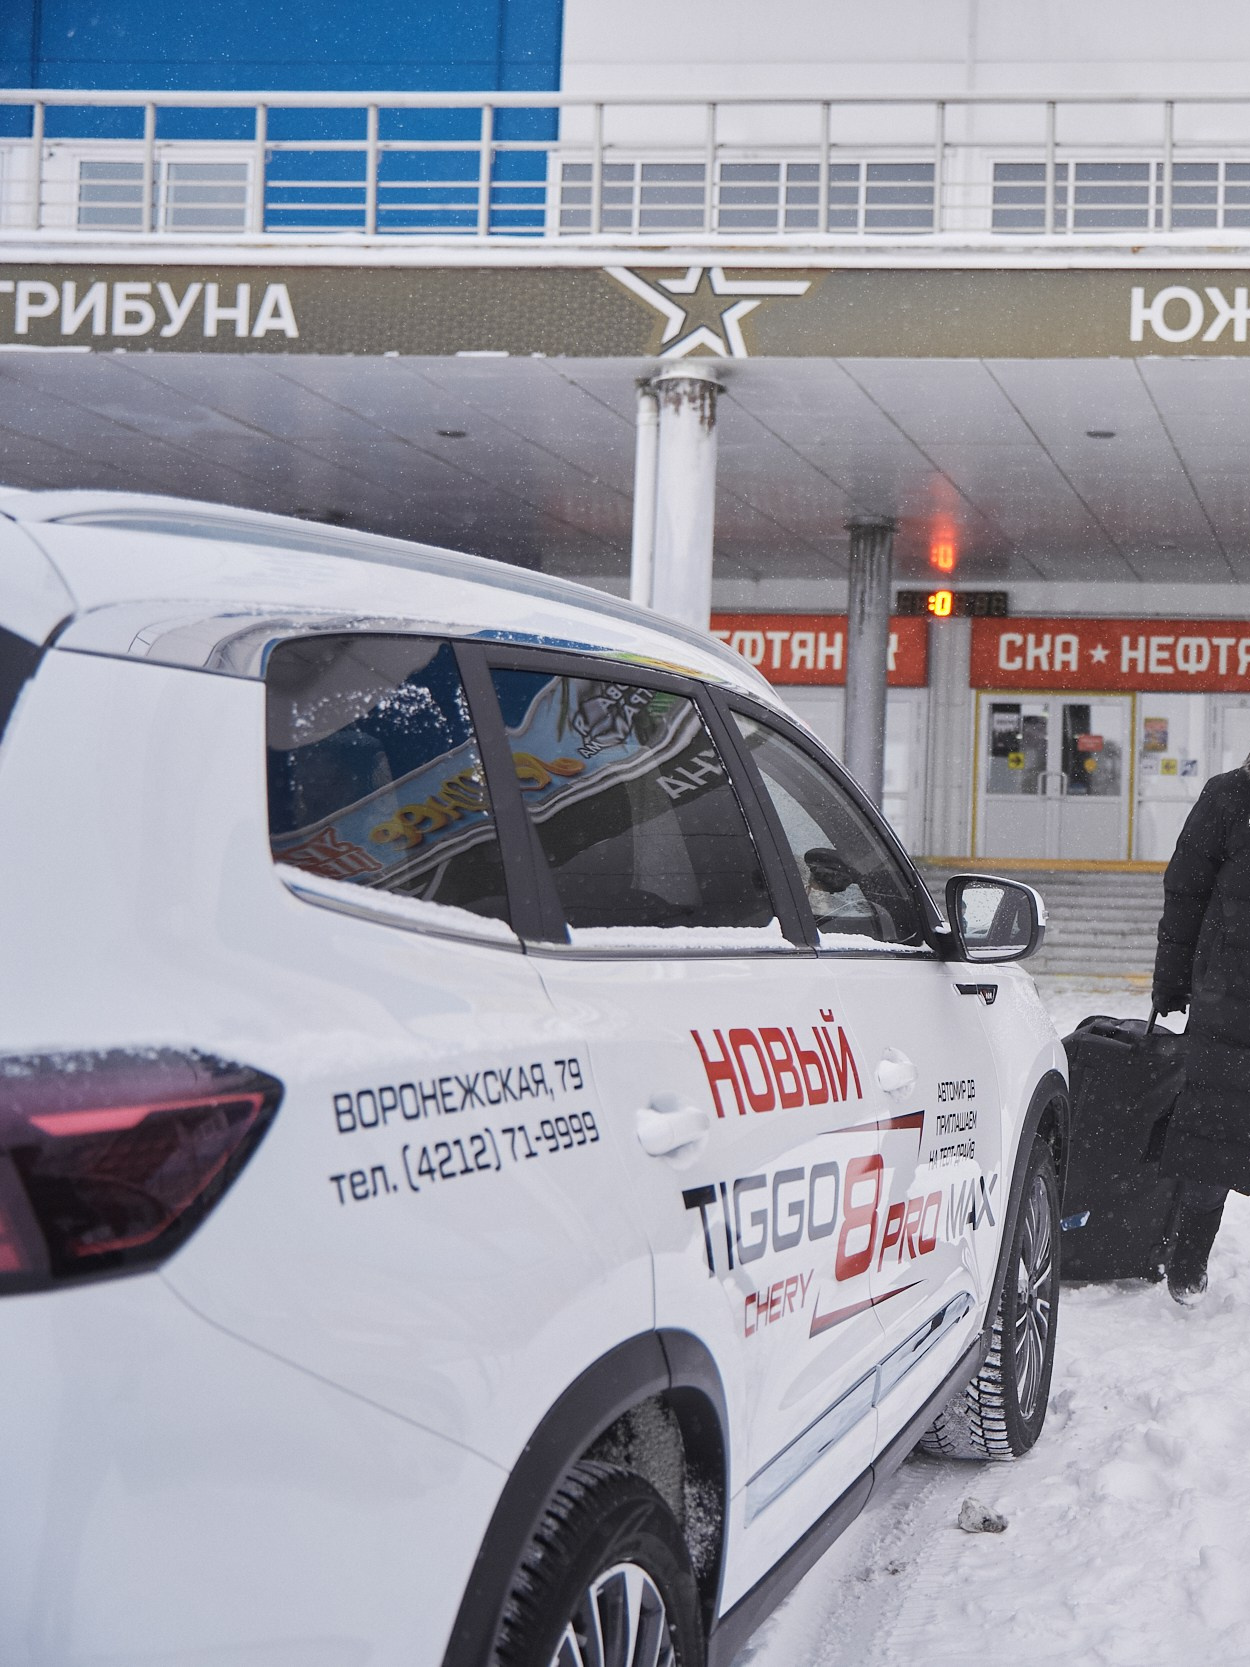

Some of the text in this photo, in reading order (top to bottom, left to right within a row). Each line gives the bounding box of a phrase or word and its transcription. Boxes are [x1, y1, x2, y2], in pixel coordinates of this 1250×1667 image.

[999, 632, 1080, 672] СКА
[333, 1058, 583, 1134] ВОРОНЕЖСКАЯ, 79
[690, 1009, 863, 1119] НОВЫЙ
[937, 1080, 966, 1103] АВТОМИР
[330, 1111, 600, 1206] тел. (4212) 71-9999
[682, 1153, 998, 1282] TIGGO 8 PRO MAX
[743, 1268, 815, 1338] CHERY
